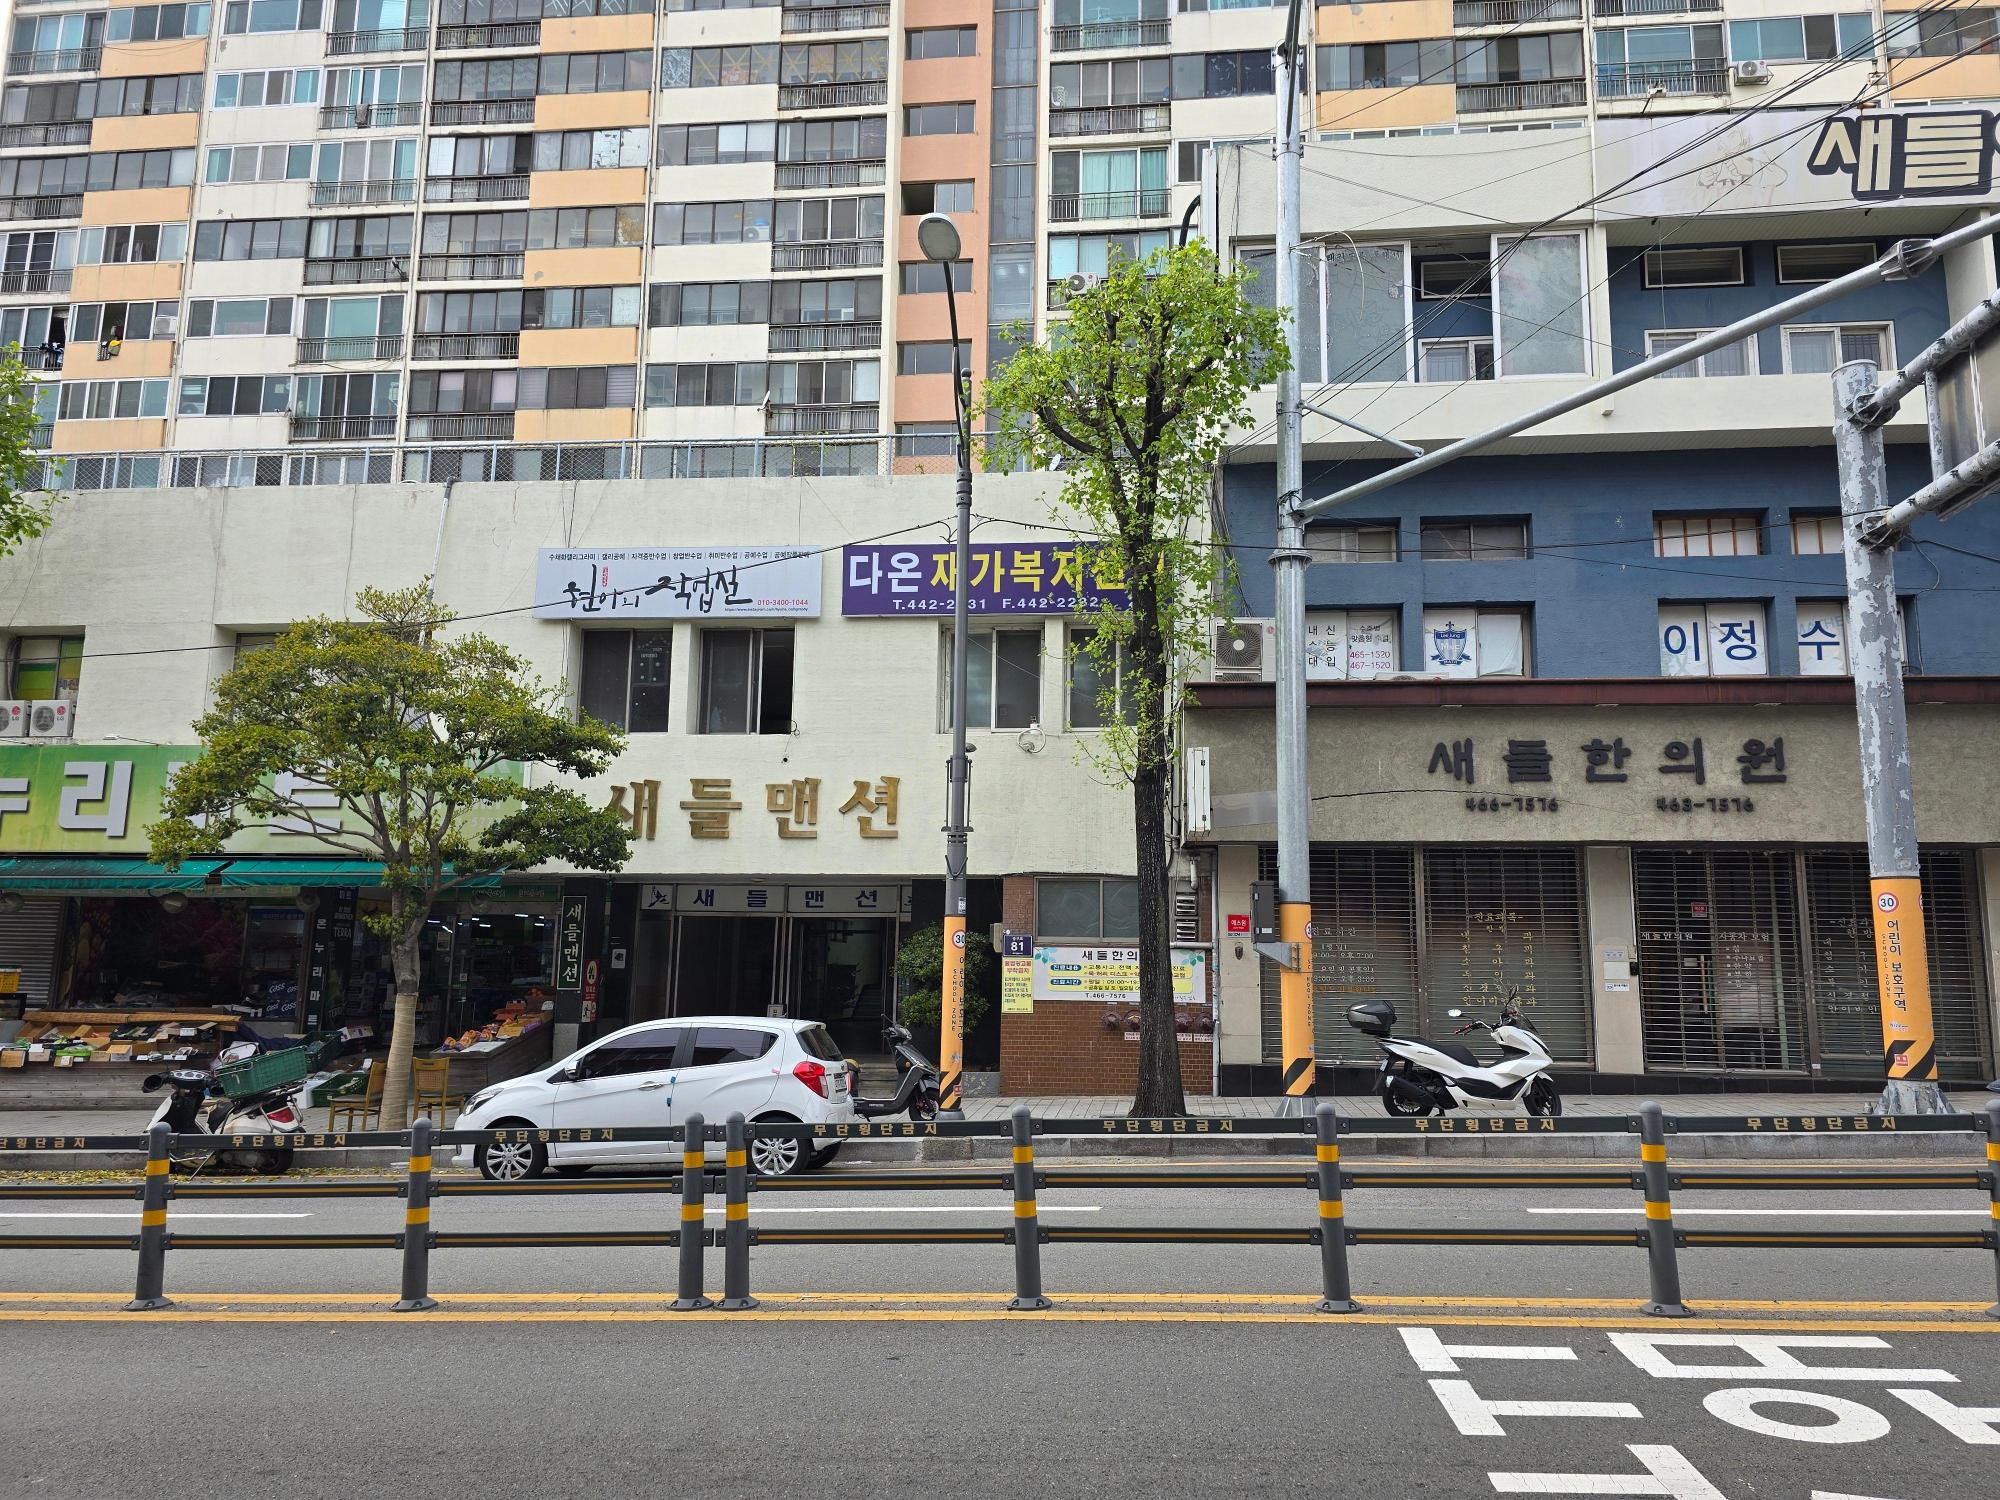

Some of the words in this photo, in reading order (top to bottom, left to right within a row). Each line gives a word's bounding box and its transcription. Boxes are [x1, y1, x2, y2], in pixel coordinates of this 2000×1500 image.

[1807, 110, 2000, 201] 새들
[849, 551, 921, 594] 다온
[930, 549, 1166, 593] 재가복지
[645, 565, 753, 614] 작업실
[893, 599, 986, 610] T.442-231
[1350, 661, 1391, 669] 467-1520
[1428, 737, 1788, 785] 새들한의원
[609, 776, 901, 841] 새들맨션
[693, 888, 878, 908] 새들맨션
[1879, 897, 1895, 907] 30
[562, 903, 582, 983] 새들맨션
[955, 934, 965, 943] 30
[1887, 918, 1902, 957] 어린이
[1010, 941, 1024, 951] 81
[1881, 933, 1889, 969] SCHOOL
[1082, 950, 1140, 961] 새들한의
[269, 982, 286, 993] Cass
[1891, 962, 1907, 1012] 보호구역
[281, 1001, 297, 1013] Cass
[814, 1121, 938, 1136] 무단횡단금지
[1103, 1118, 1235, 1133] 무단횡단금지
[1415, 1117, 1556, 1131] 무단횡단금지
[1747, 1116, 1897, 1130] 무단횡단금지
[232, 1133, 347, 1148] 무단횡단금지
[494, 1128, 614, 1143] 무단횡단금지
